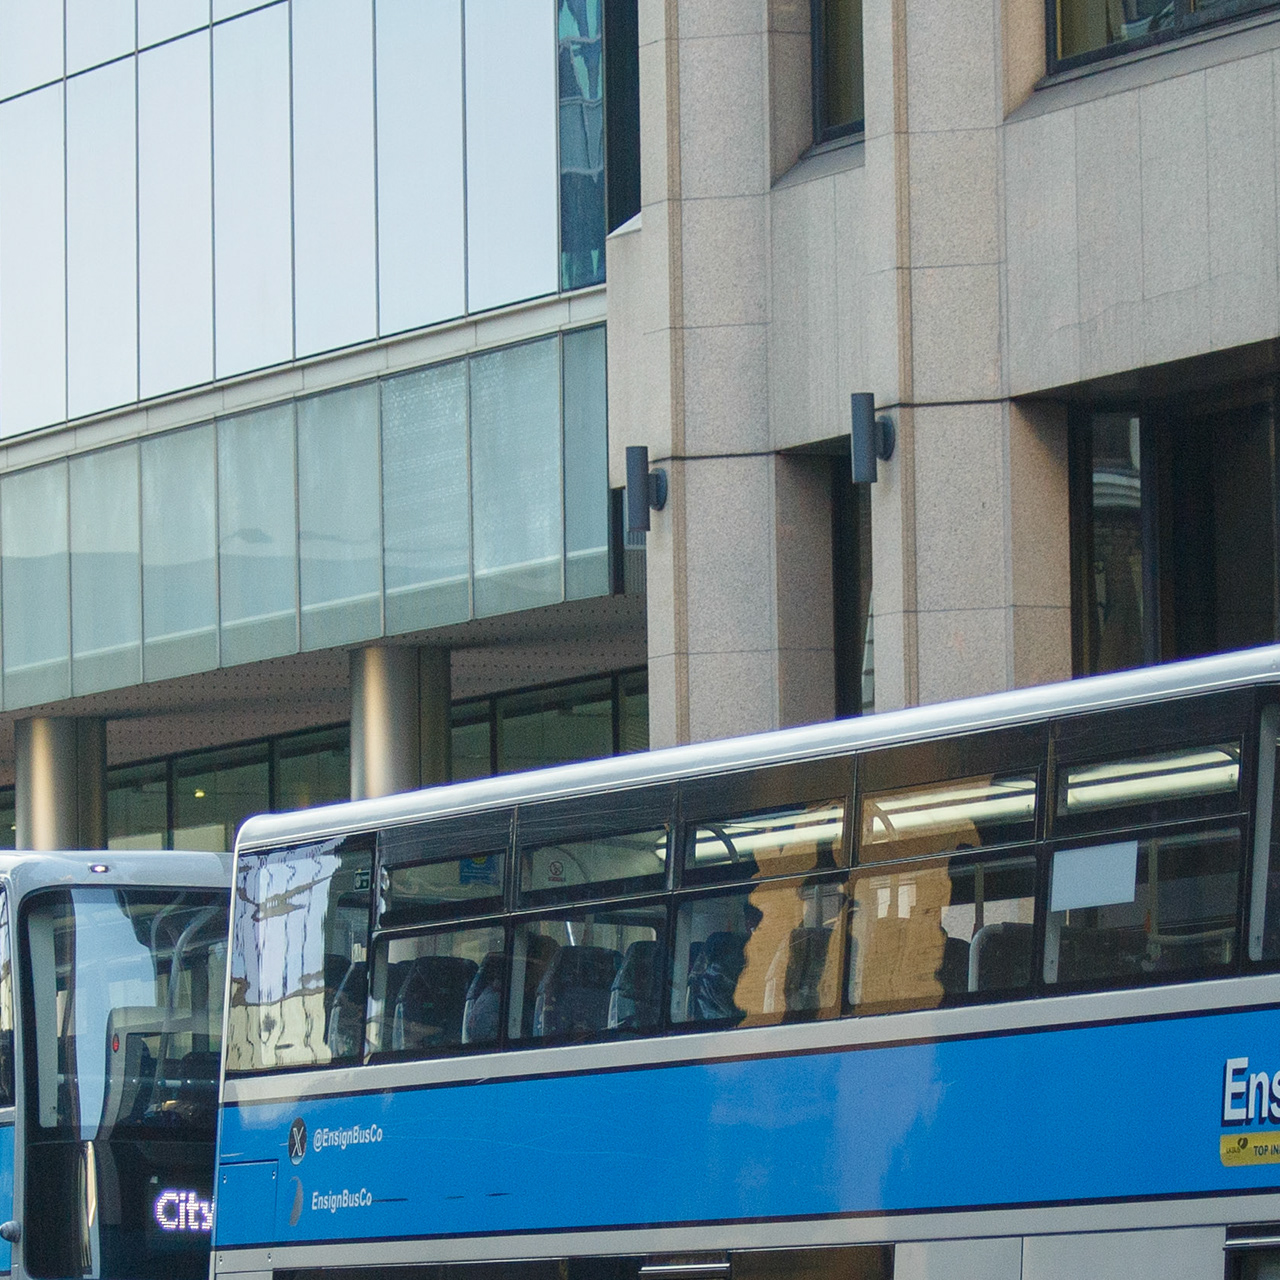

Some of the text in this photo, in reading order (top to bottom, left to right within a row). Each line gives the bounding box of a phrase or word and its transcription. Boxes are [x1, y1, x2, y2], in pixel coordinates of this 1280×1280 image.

[313, 1124, 383, 1152] @EnsignBusCo
[1253, 1145, 1268, 1156] TOP
[156, 1191, 215, 1229] City
[311, 1188, 372, 1213] EnsignBusCo
